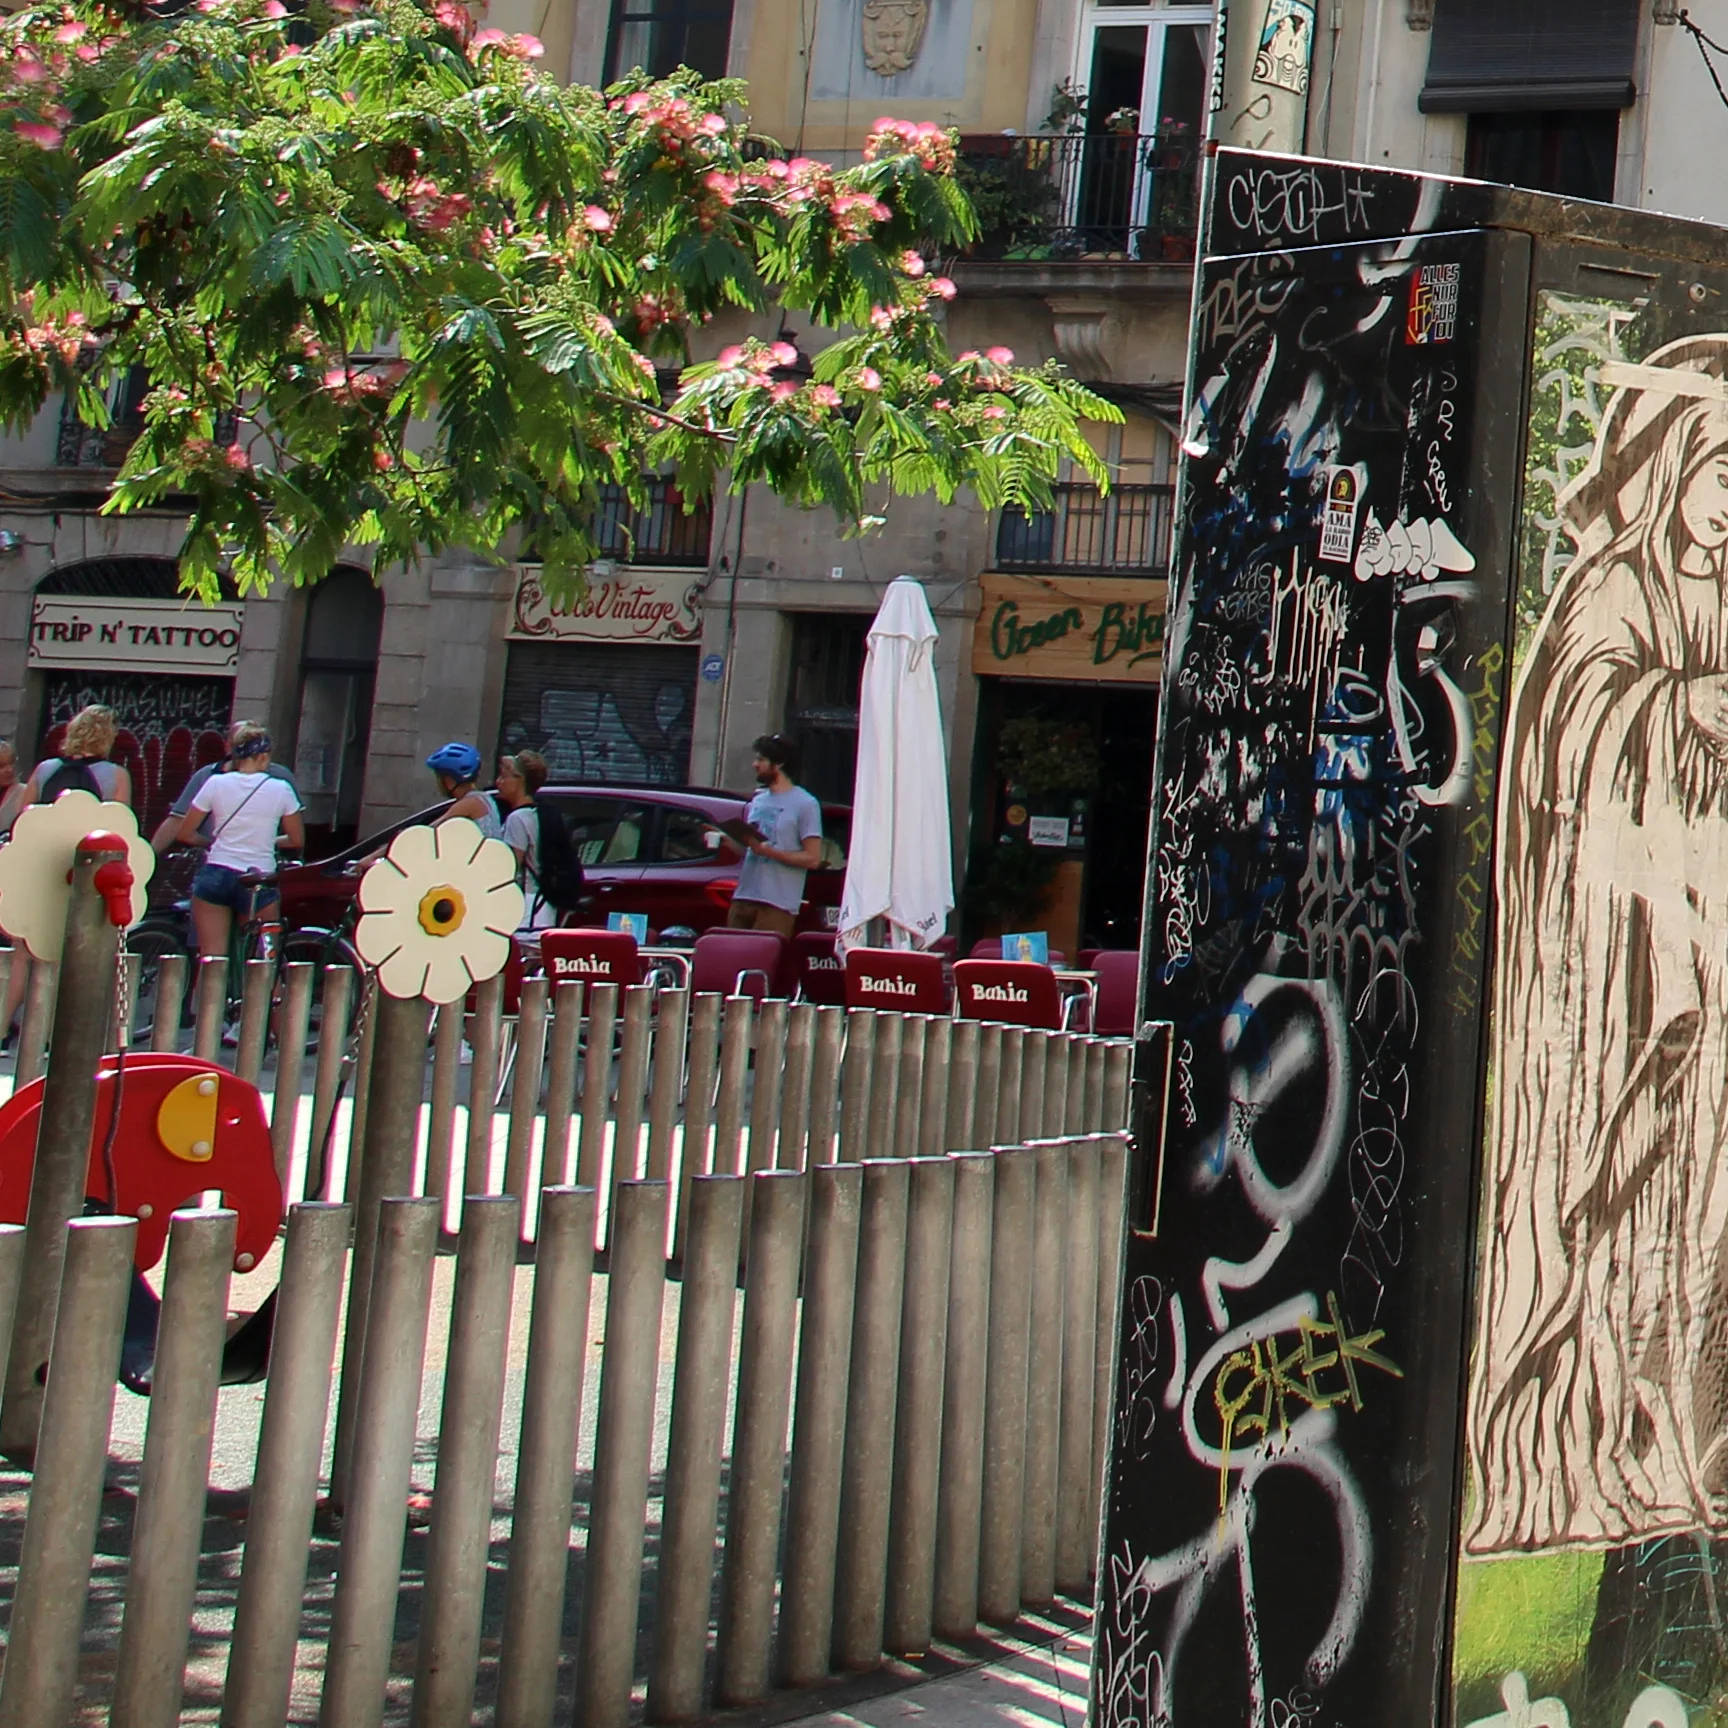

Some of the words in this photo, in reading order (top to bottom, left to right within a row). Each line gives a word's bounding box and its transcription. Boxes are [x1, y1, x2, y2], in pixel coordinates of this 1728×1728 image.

[1420, 263, 1460, 285] ALLES
[128, 625, 240, 649] TATTOO
[553, 953, 611, 975] Bahia
[859, 975, 917, 996] Bahia
[971, 981, 1029, 1003] Bahia
